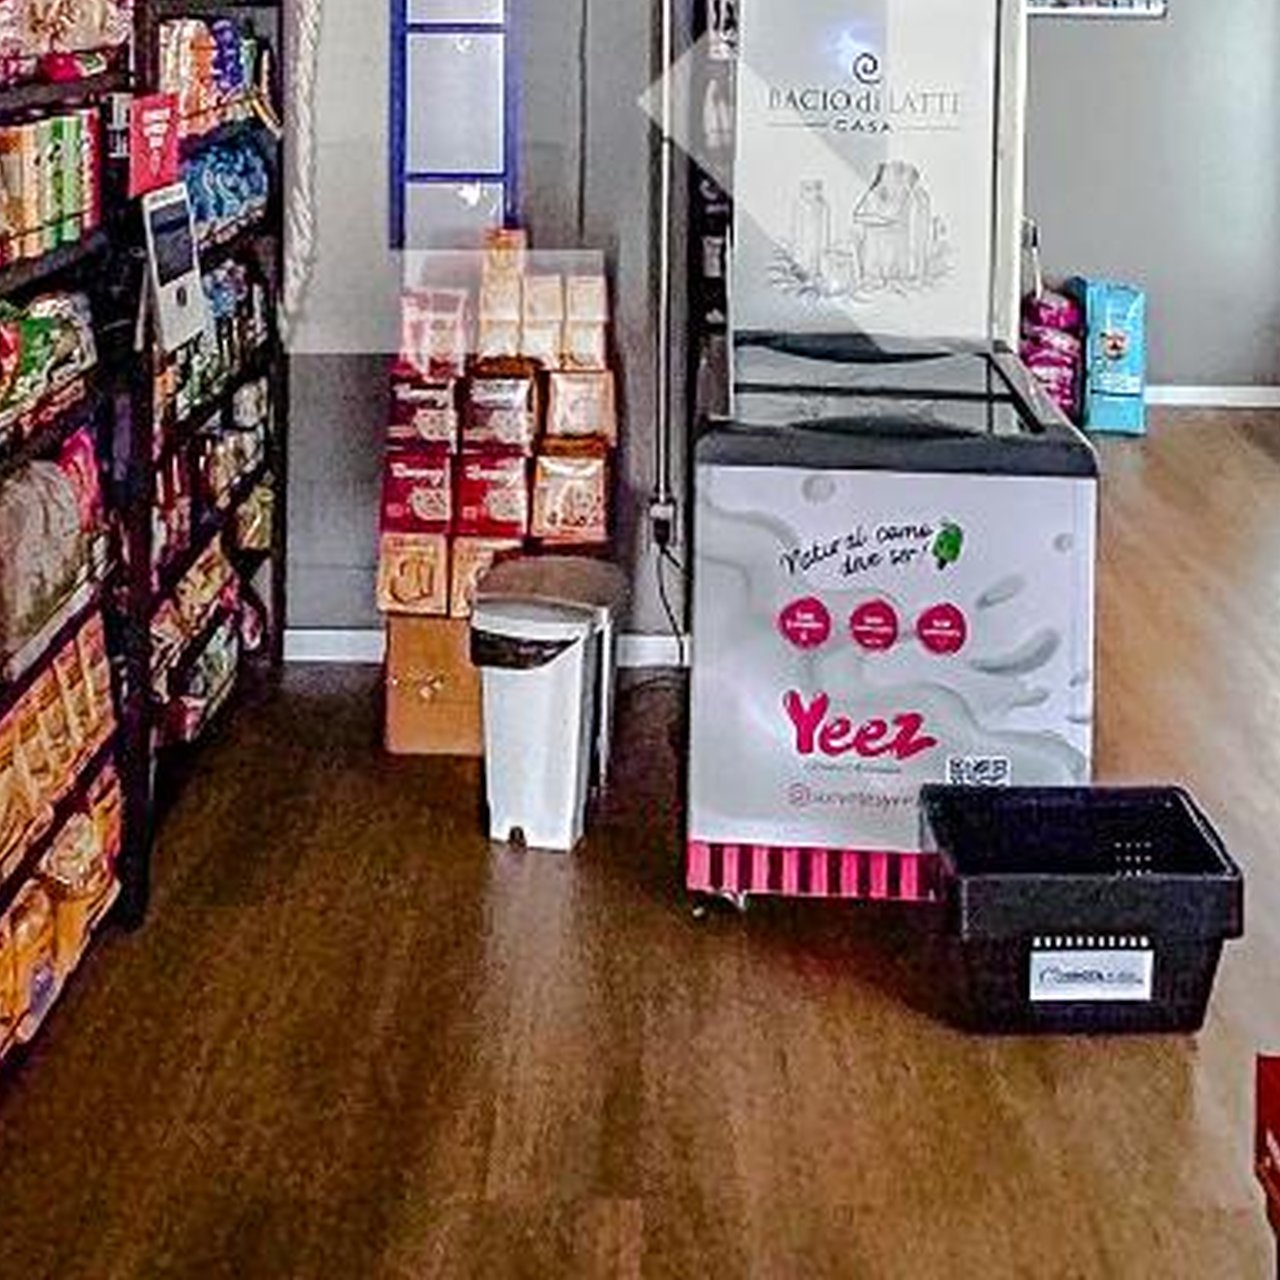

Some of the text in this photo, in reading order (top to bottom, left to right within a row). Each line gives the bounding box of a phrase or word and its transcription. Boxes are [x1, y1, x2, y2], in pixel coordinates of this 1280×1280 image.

[857, 90, 881, 113] di
[833, 119, 895, 135] CASA
[876, 523, 933, 544] como
[784, 689, 938, 760] Yeez
